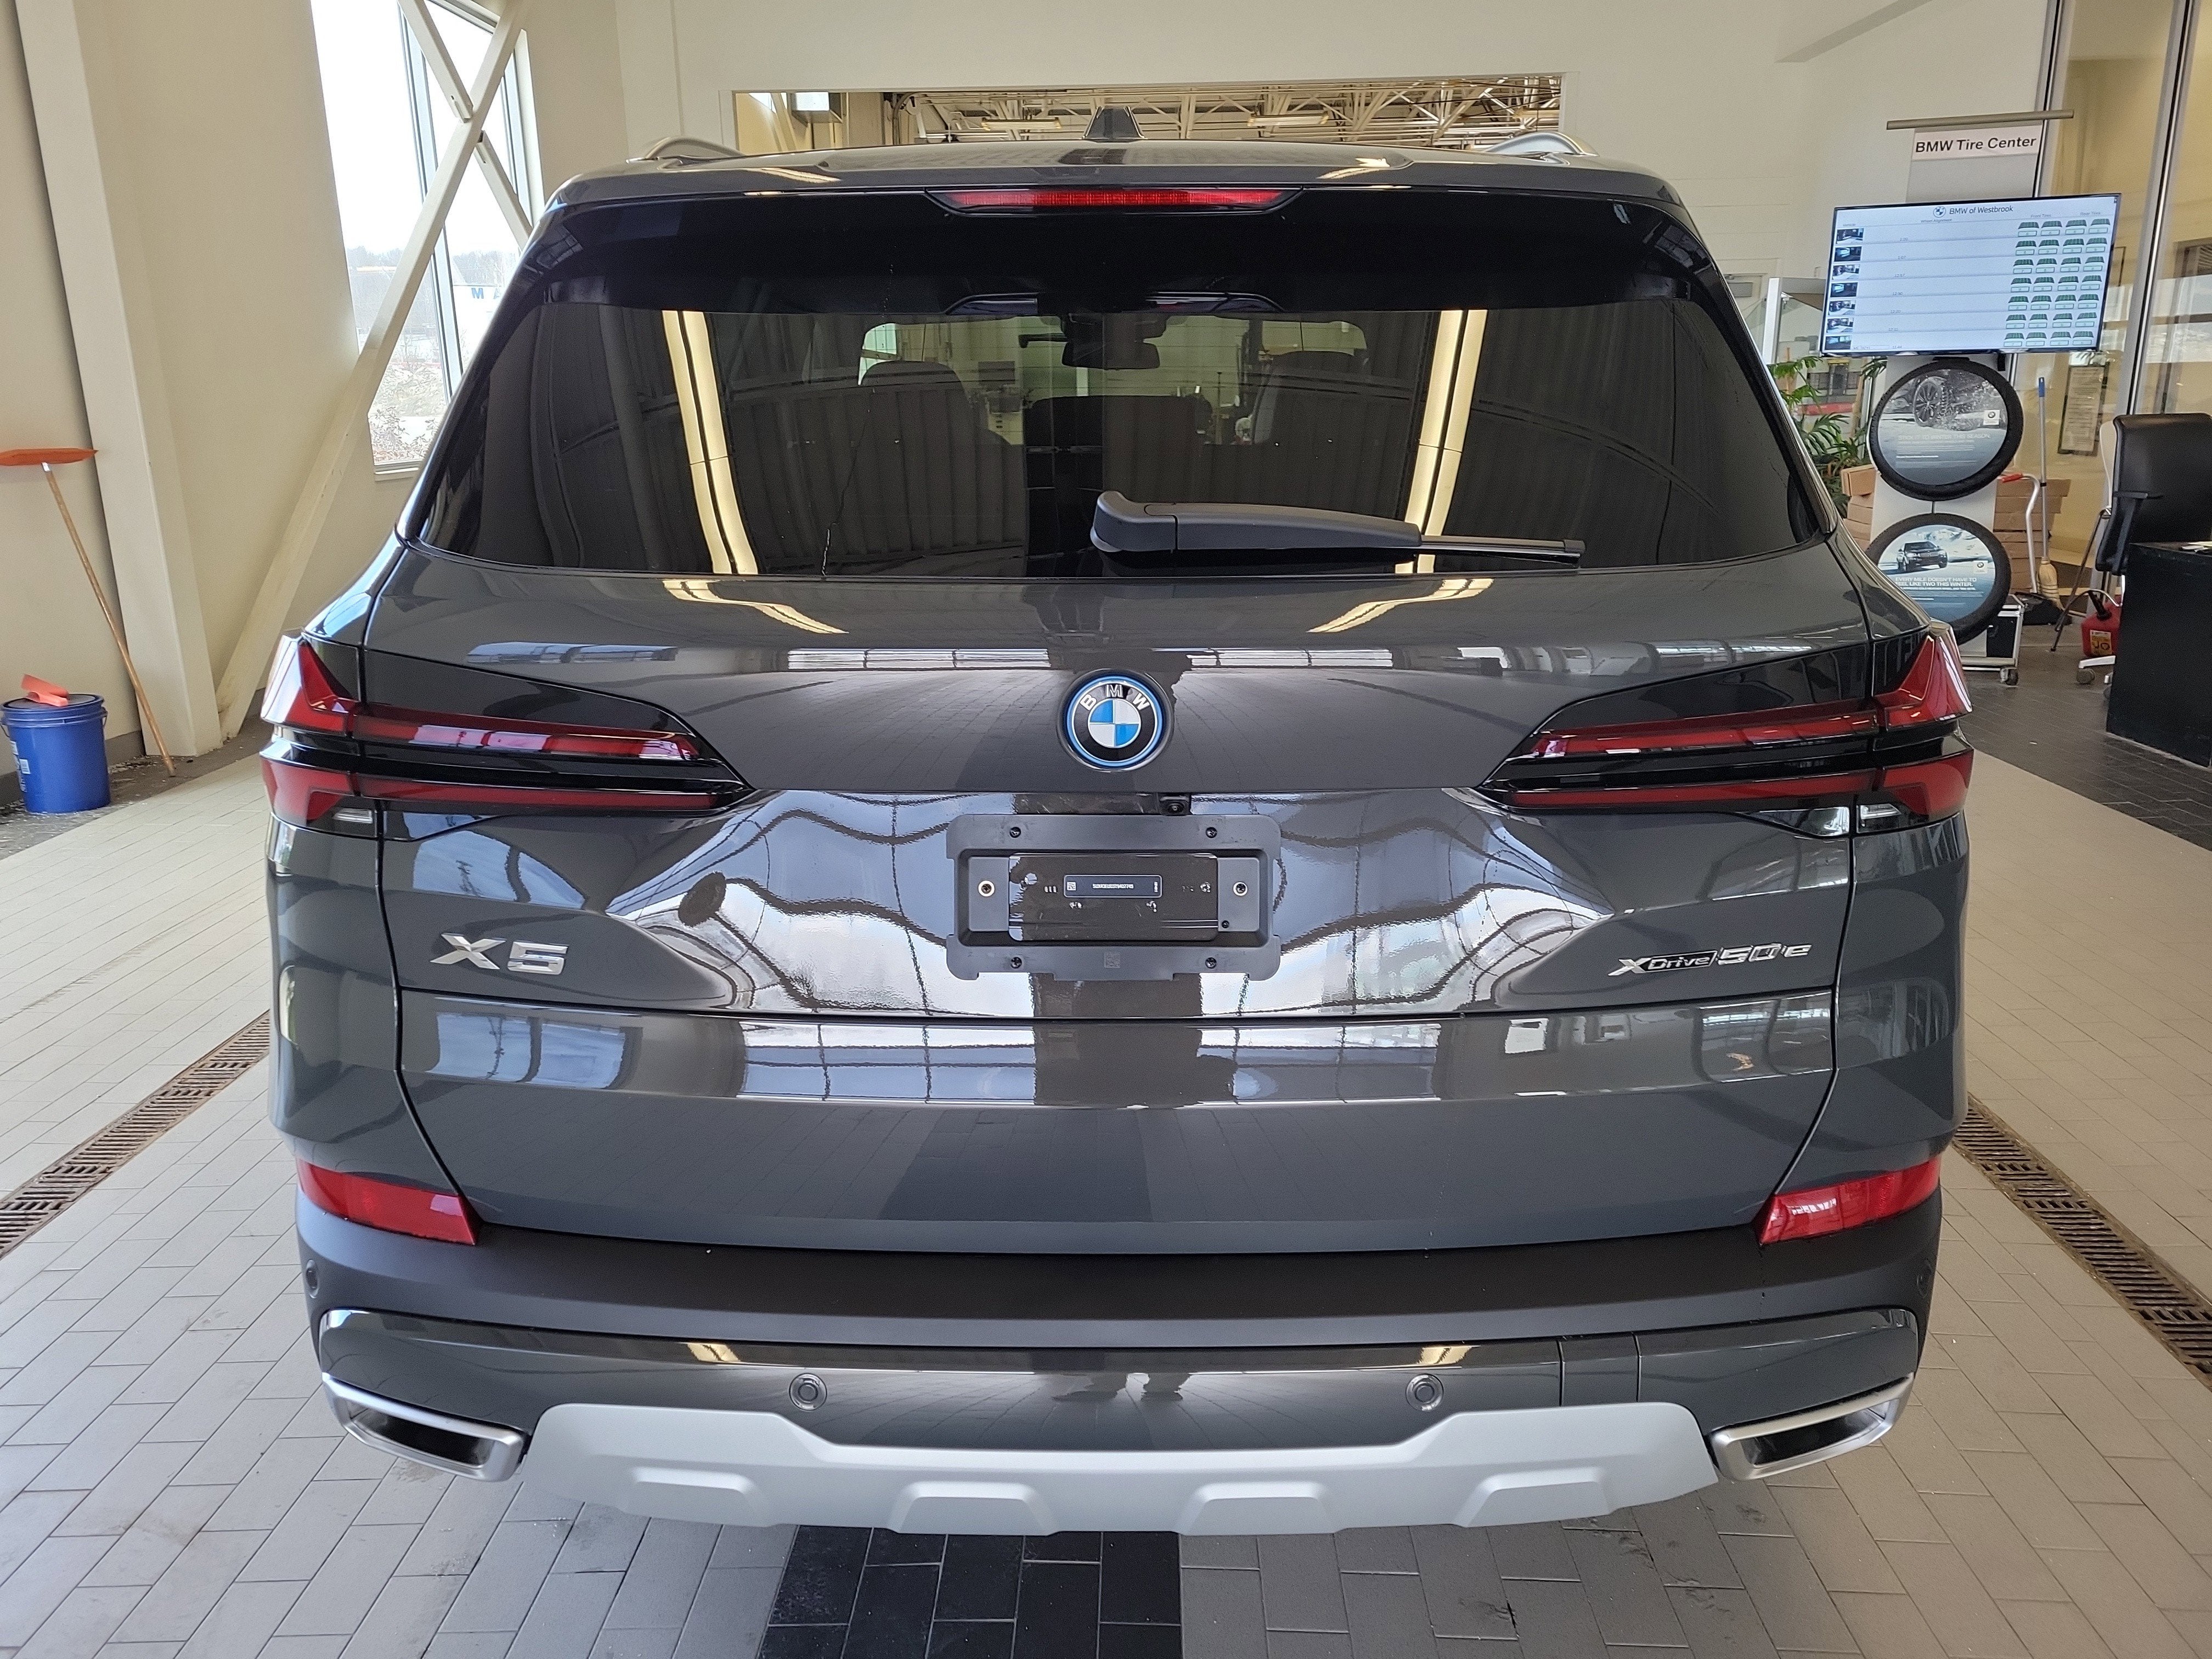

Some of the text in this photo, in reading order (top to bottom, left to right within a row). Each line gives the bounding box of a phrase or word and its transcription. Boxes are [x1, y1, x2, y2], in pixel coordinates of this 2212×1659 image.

[1915, 137, 2037, 153] BMW Tire Center
[1977, 205, 2013, 213] Westbrook
[1080, 684, 1150, 710] BMW
[430, 933, 569, 975] X5
